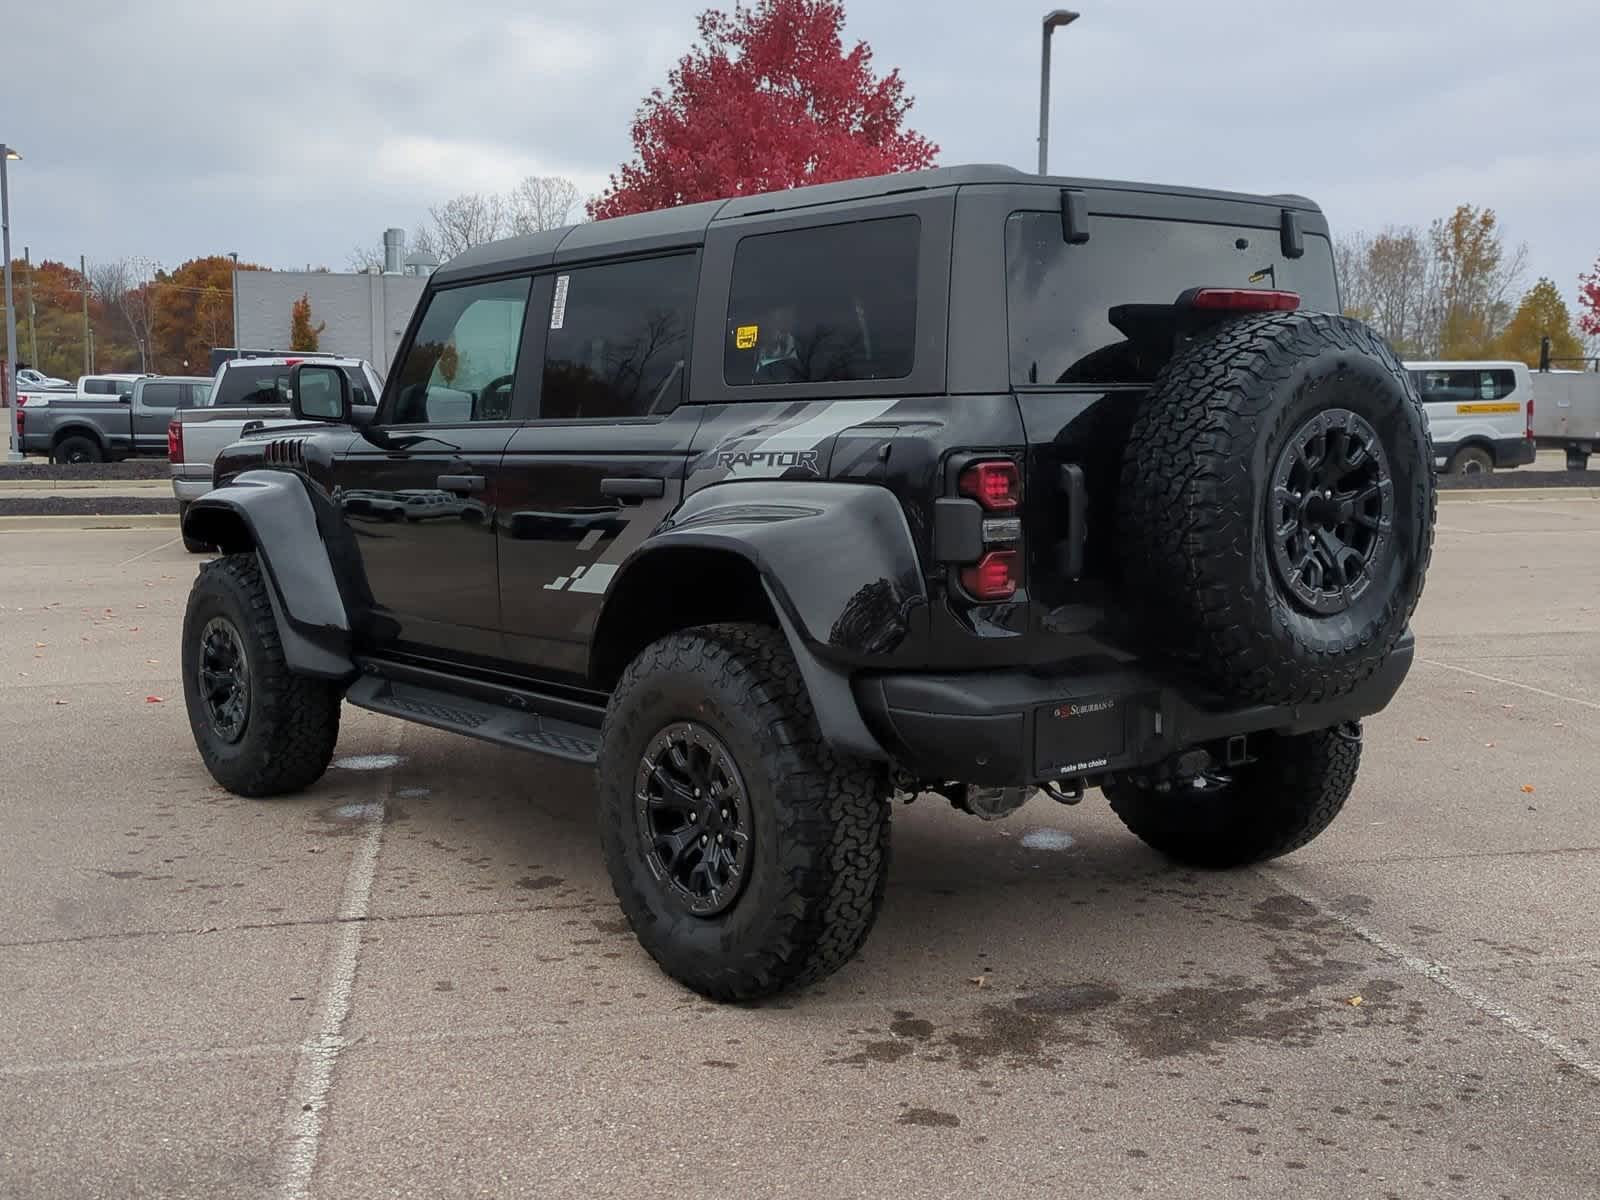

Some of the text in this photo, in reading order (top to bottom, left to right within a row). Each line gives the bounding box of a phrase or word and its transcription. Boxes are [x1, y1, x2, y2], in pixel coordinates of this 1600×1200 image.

[718, 450, 820, 476] RAPTOR
[1060, 764, 1076, 773] make
[1088, 759, 1106, 768] choice
